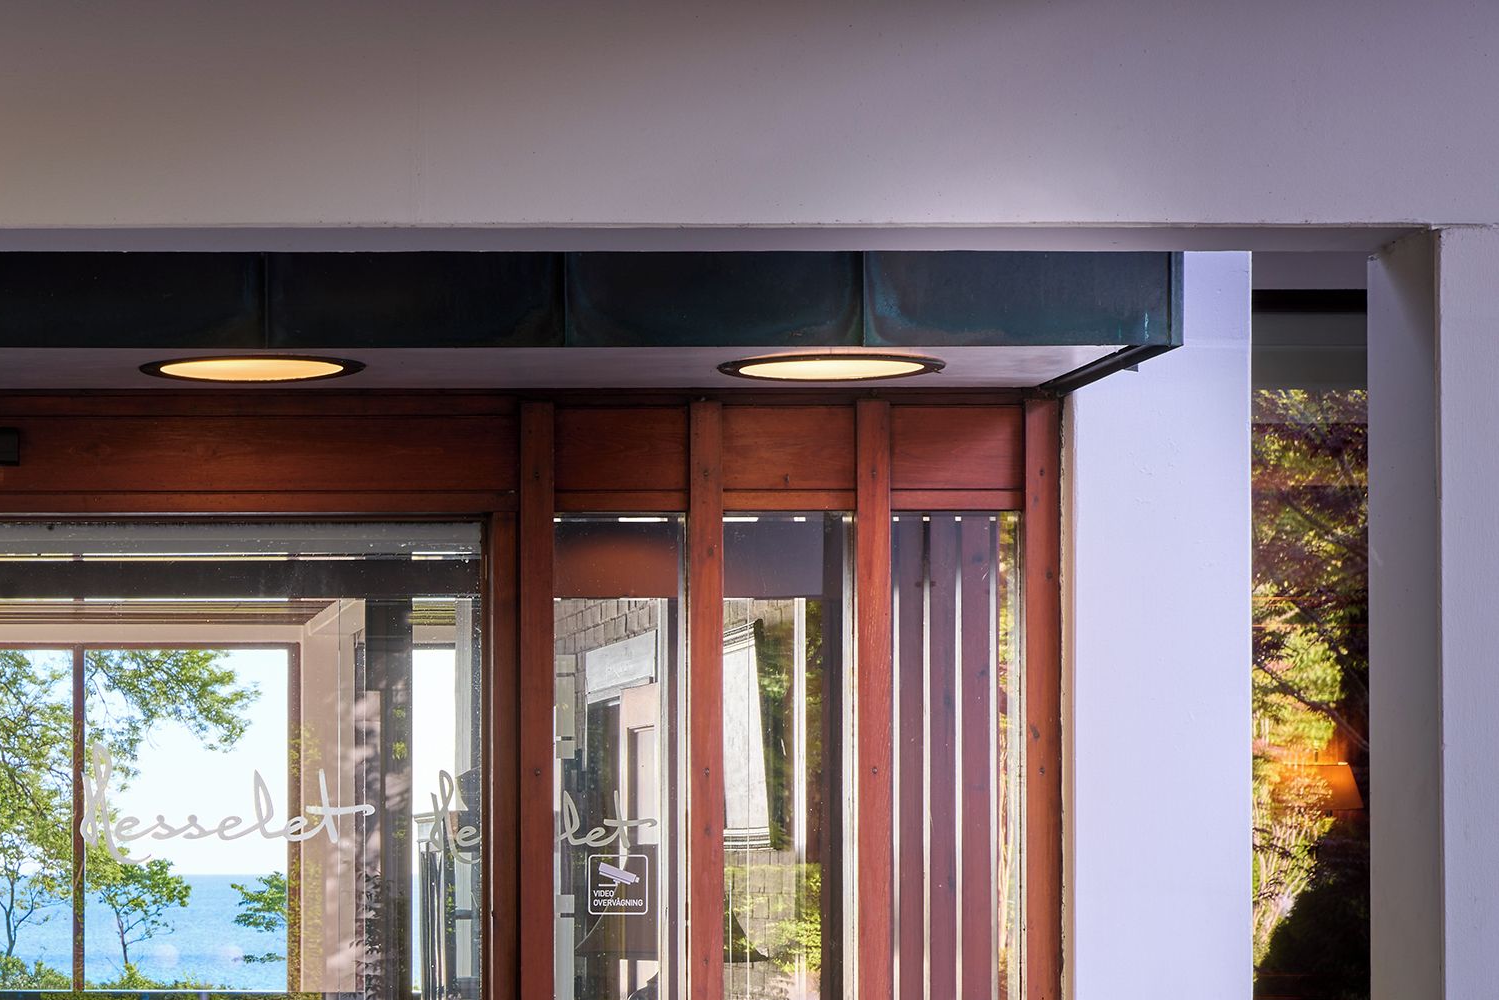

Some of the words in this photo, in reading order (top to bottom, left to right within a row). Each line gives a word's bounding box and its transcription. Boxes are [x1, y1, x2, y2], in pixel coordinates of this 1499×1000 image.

[80, 742, 376, 865] Hesselet
[593, 889, 615, 897] VIDEO
[593, 898, 643, 906] OVERVÅGNING
